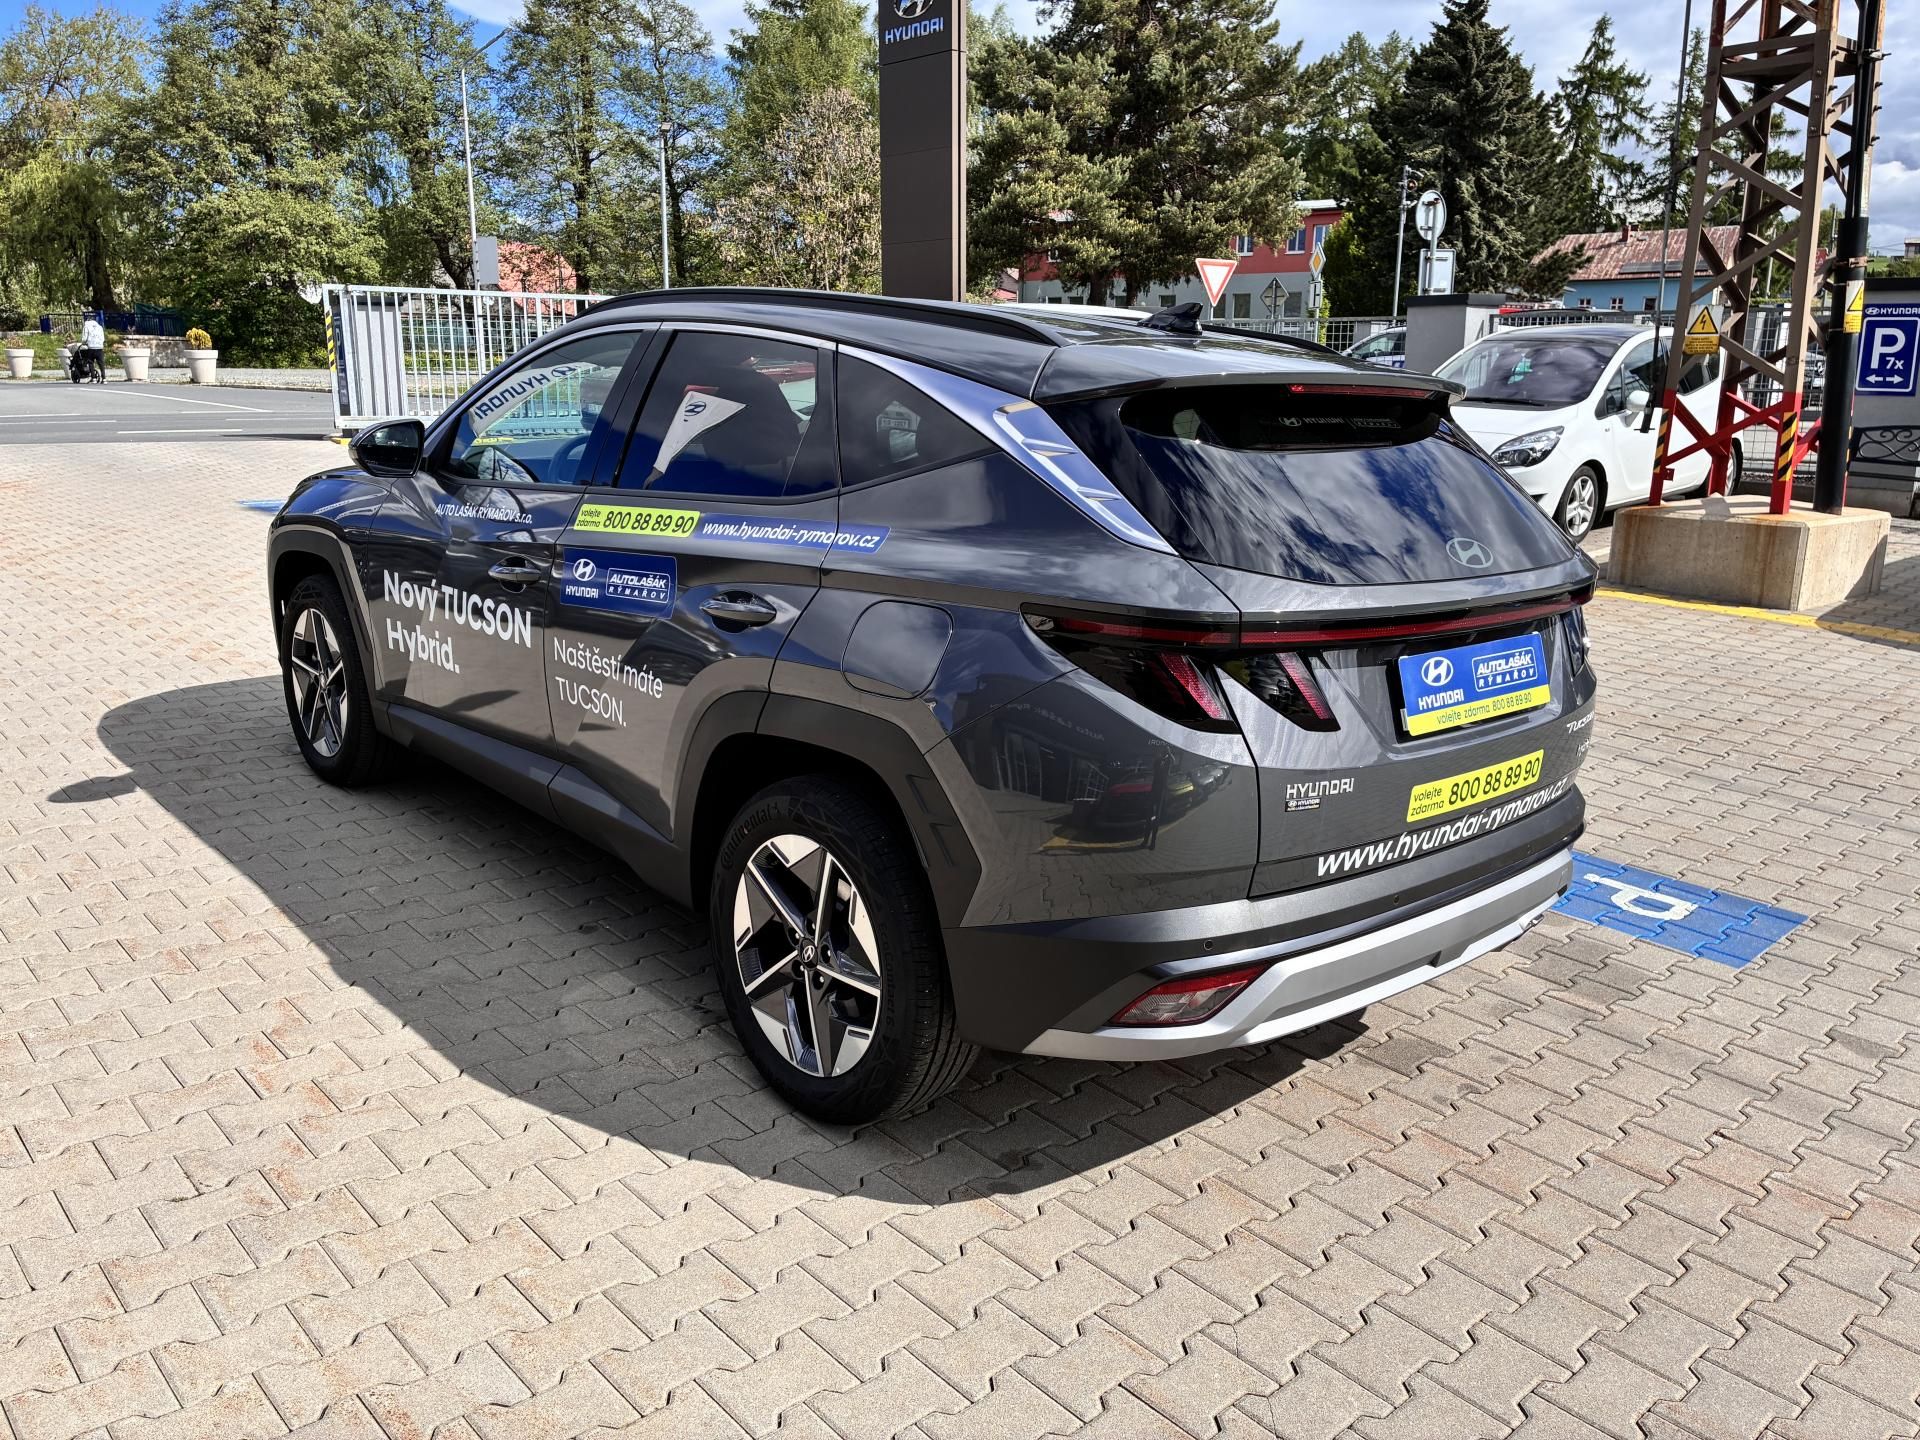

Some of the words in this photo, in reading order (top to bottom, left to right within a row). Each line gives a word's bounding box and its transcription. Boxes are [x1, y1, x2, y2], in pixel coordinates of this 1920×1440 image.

[885, 17, 944, 45] HYUNDAI
[1870, 327, 1906, 369] P
[1886, 357, 1905, 370] 7x
[435, 503, 454, 515] AUTO
[454, 502, 479, 518] LAŠÁK
[479, 503, 515, 521] RÝMAŘOV
[514, 514, 533, 524] s.r.o.
[576, 519, 600, 528] zdarma
[581, 509, 601, 518] volejte
[603, 510, 631, 530] 800
[631, 512, 652, 531] 88
[651, 514, 673, 532] 89
[672, 515, 694, 534] 90
[702, 521, 881, 548] www.hyundai-rymarov.cz
[565, 585, 599, 599] HYUNDAI
[608, 585, 666, 600] RÝMAŘOV
[609, 573, 667, 589] AUTOLAŠÁK
[384, 569, 439, 622] Nový
[441, 584, 532, 649] TUCSON
[386, 618, 460, 675] Hybrid.
[554, 636, 621, 681] Naštěstí
[623, 664, 663, 699] máte
[1476, 652, 1532, 676] AUTOLAŠÁK
[1479, 667, 1535, 688] RÝMAŘOV
[555, 676, 627, 727] TUCSON.
[1418, 688, 1465, 710] HYUNDAI
[1436, 711, 1462, 725] volejte
[1464, 704, 1491, 717] zdarma
[1492, 697, 1506, 711] 800
[1505, 695, 1515, 708] 88
[1515, 693, 1523, 706] 89
[1523, 692, 1532, 704] 90
[1286, 777, 1355, 799] HYUNDAI
[1449, 776, 1481, 806] 800
[1483, 769, 1503, 795] 88
[1504, 763, 1522, 788] 89
[1523, 756, 1541, 782] 90
[1413, 786, 1443, 803] volejte
[1410, 799, 1445, 817] zdarma
[1317, 776, 1569, 877] www.hyundai-rymarov.cz
